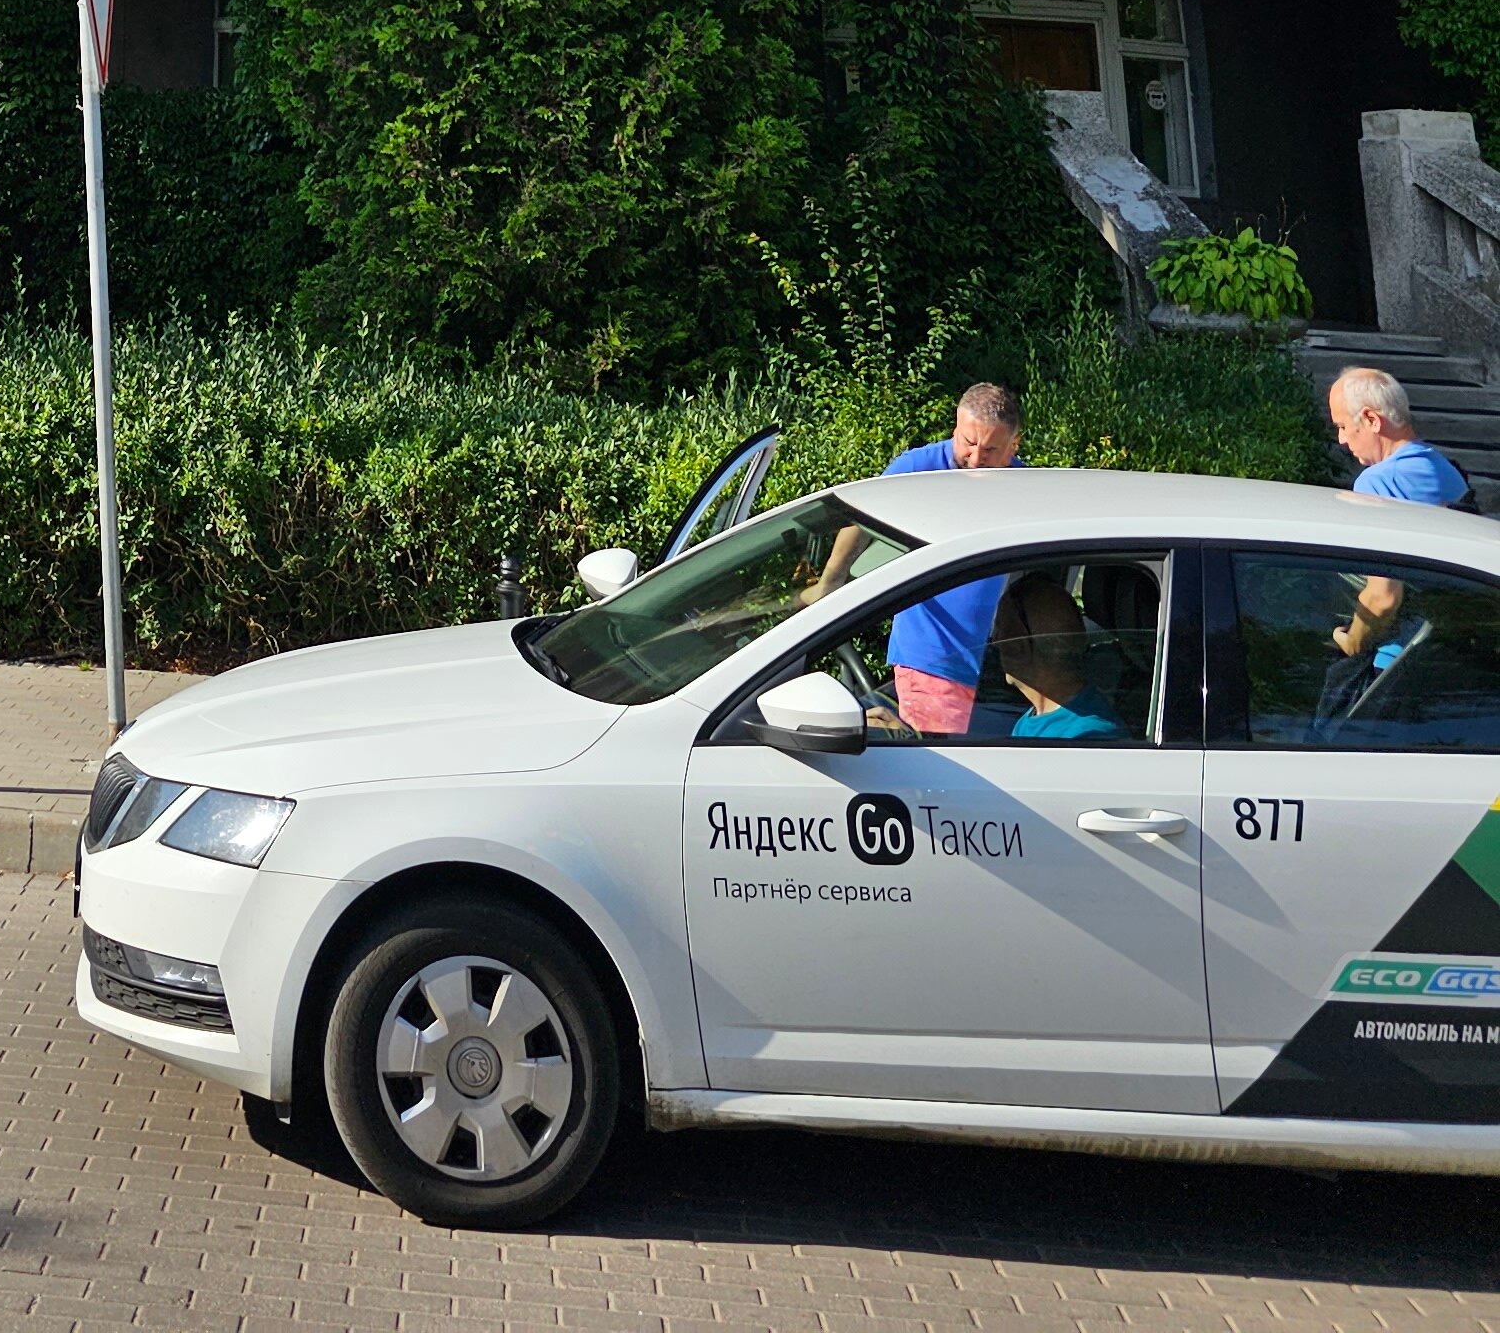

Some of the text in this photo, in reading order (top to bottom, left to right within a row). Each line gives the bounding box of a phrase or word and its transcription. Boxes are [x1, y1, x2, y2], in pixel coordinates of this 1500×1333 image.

[707, 801, 1024, 858] Яндекс Go Такси
[1233, 797, 1304, 842] 877
[712, 877, 912, 905] Партнёр сервиса
[1349, 968, 1422, 987] ECO
[1353, 1020, 1459, 1043] АВТОМОБИЛЬ
[1461, 1024, 1483, 1044] НА
